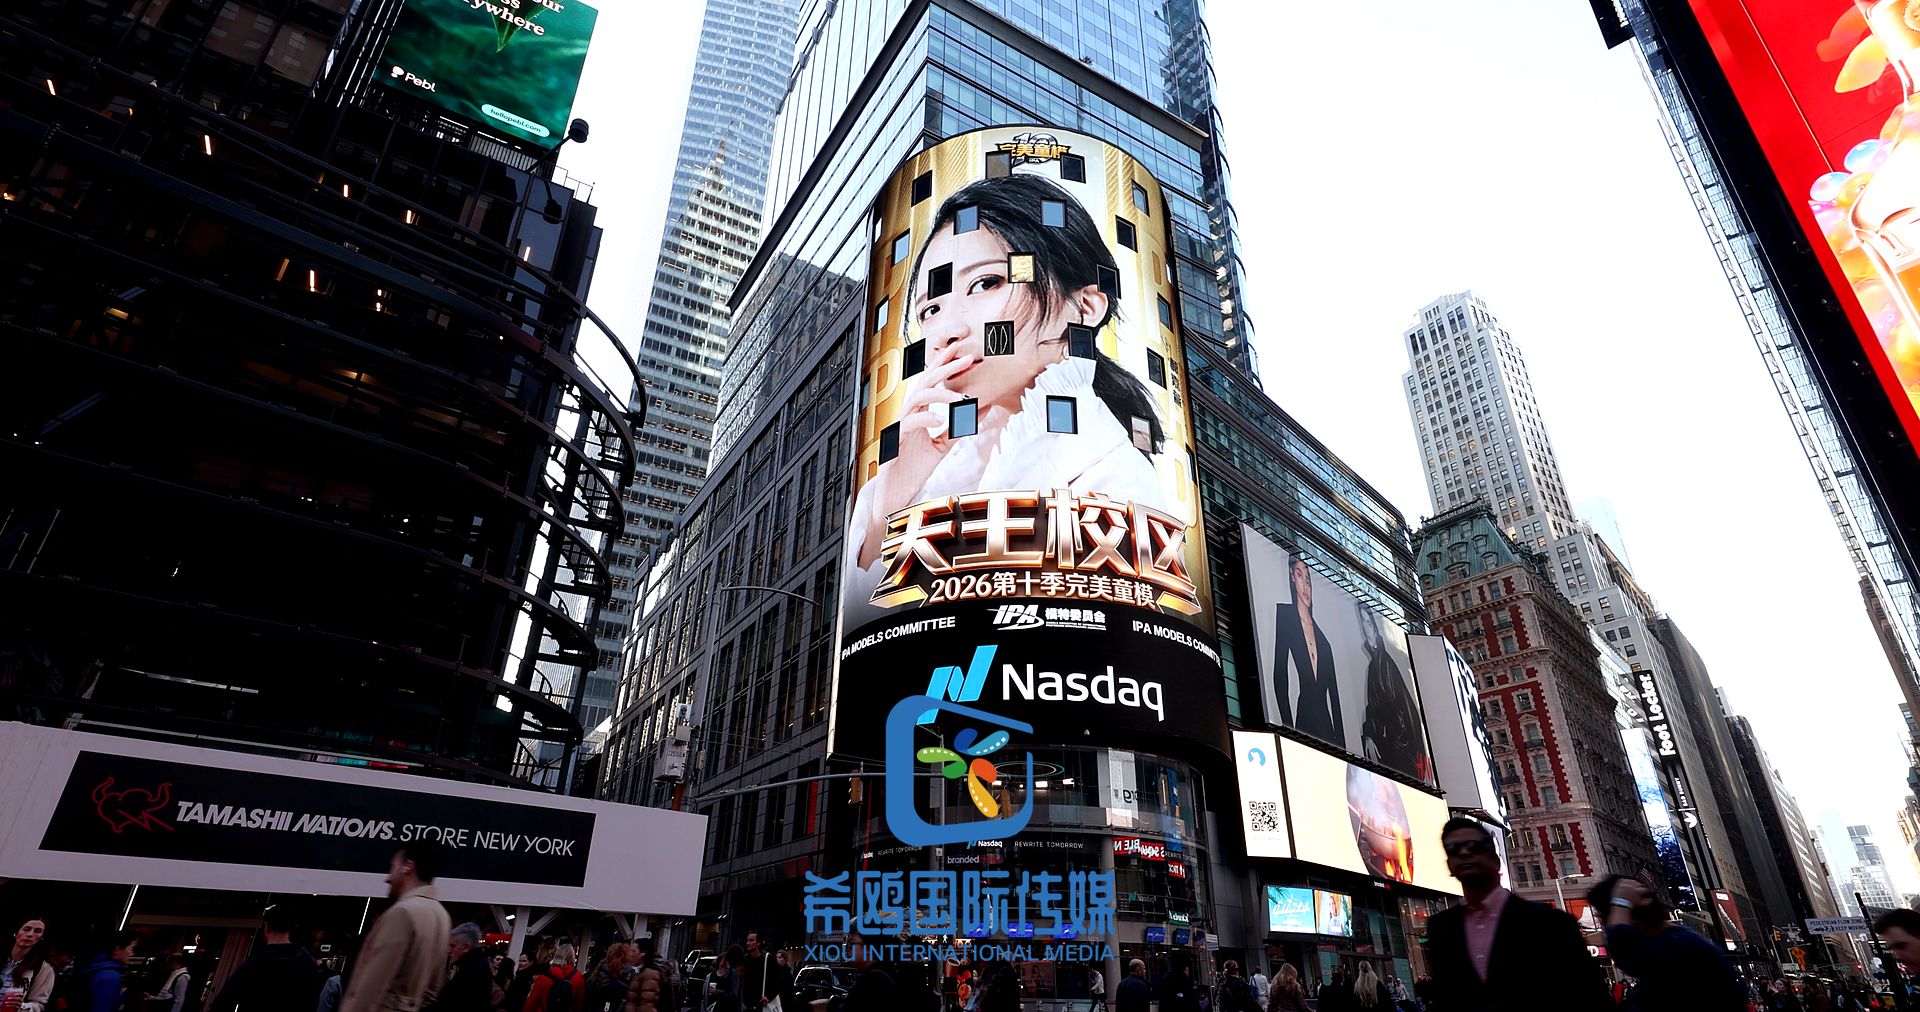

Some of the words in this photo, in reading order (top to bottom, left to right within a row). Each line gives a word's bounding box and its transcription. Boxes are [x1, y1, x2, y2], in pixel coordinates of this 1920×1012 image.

[463, 0, 545, 36] ywhere
[404, 72, 436, 92] Pebl
[490, 108, 542, 133] hellopebl.com
[876, 487, 1198, 598] 天王校区
[930, 571, 1157, 609] 2026第十季完美童模
[992, 604, 1039, 625] IPA
[851, 632, 883, 655] MODELS
[885, 616, 956, 640] COMMITTEE
[1132, 620, 1152, 635] IPA
[1153, 625, 1192, 647] MODELS
[1003, 663, 1165, 722] Nasdaq
[1653, 723, 1676, 755] Foot
[176, 801, 293, 831] TAMASHII
[292, 813, 395, 840] NATIONS
[473, 830, 521, 851] NEW
[523, 835, 576, 857] YORK
[978, 840, 1002, 850] Nasdaq
[1014, 841, 1044, 849] REWRITE
[1047, 841, 1084, 850] TOMORROW
[947, 856, 980, 864] branded
